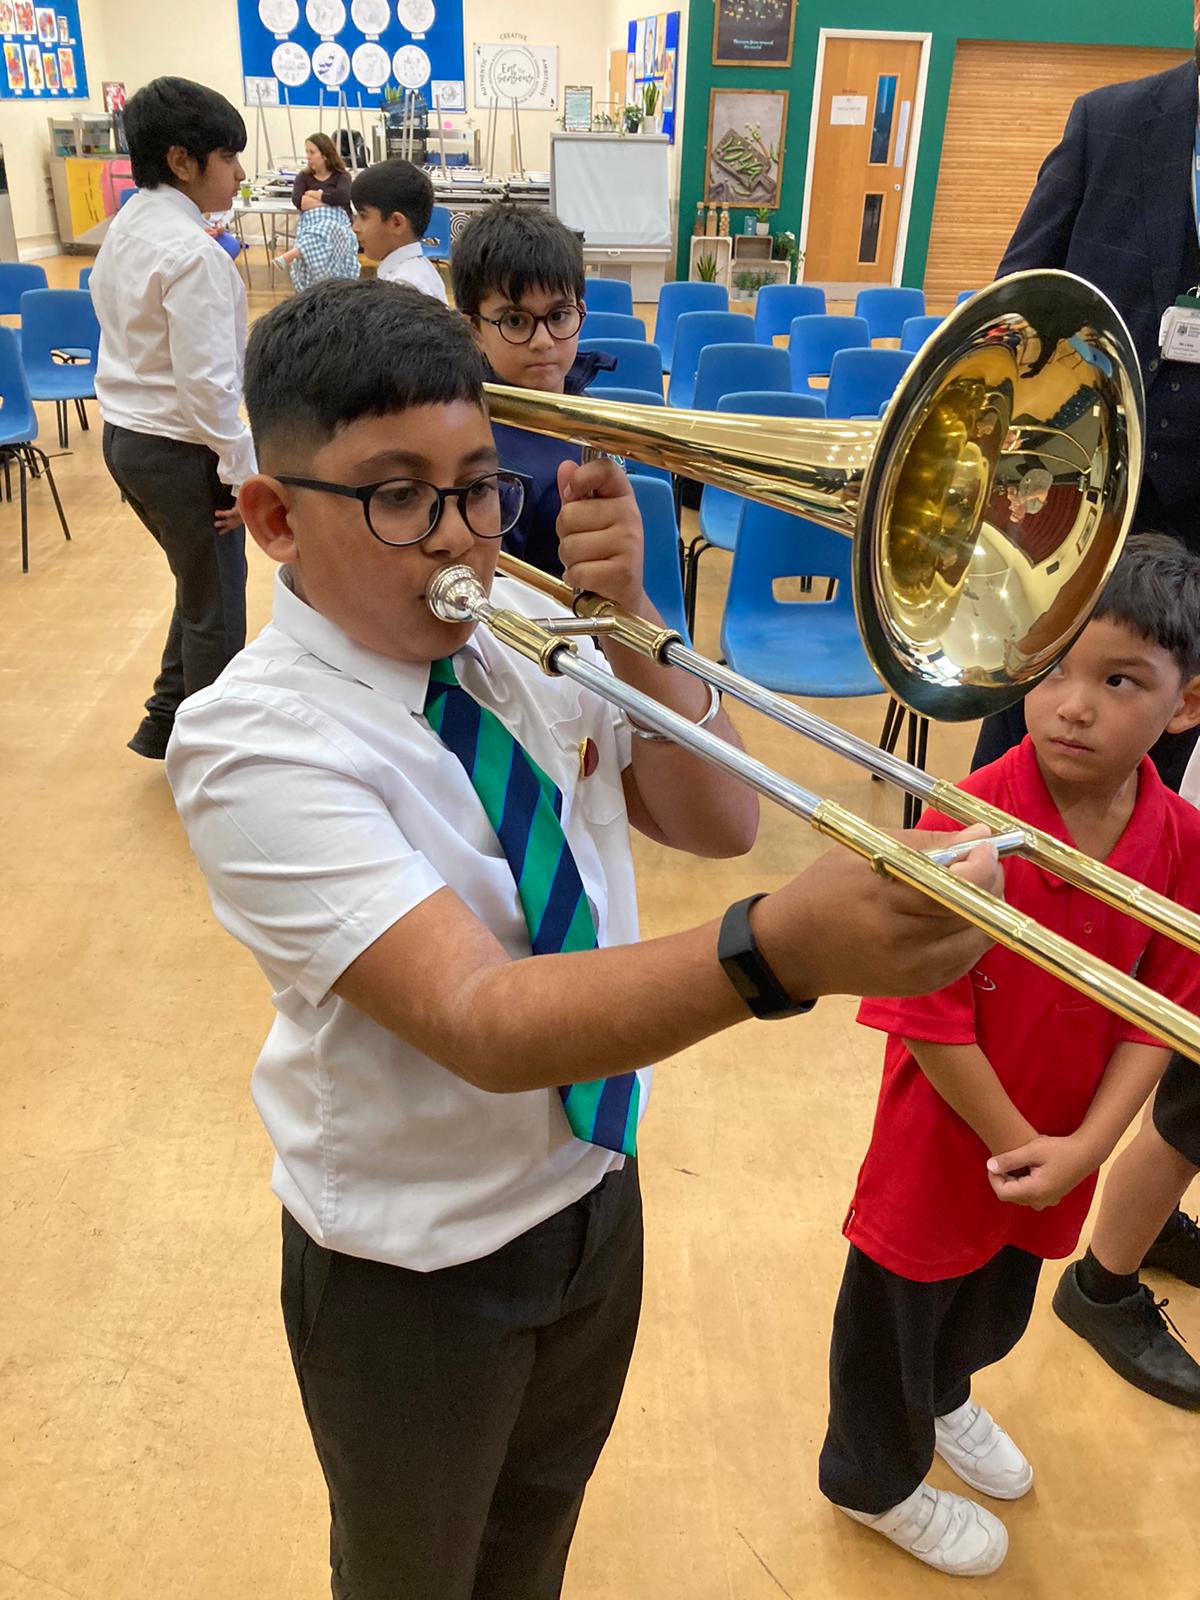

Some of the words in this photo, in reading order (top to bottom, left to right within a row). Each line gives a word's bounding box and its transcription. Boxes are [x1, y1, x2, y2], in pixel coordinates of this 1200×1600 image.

[499, 32, 528, 41] CREATIVE
[480, 58, 488, 96] AUTHENTIC
[539, 59, 549, 96] AMBITIOUS
